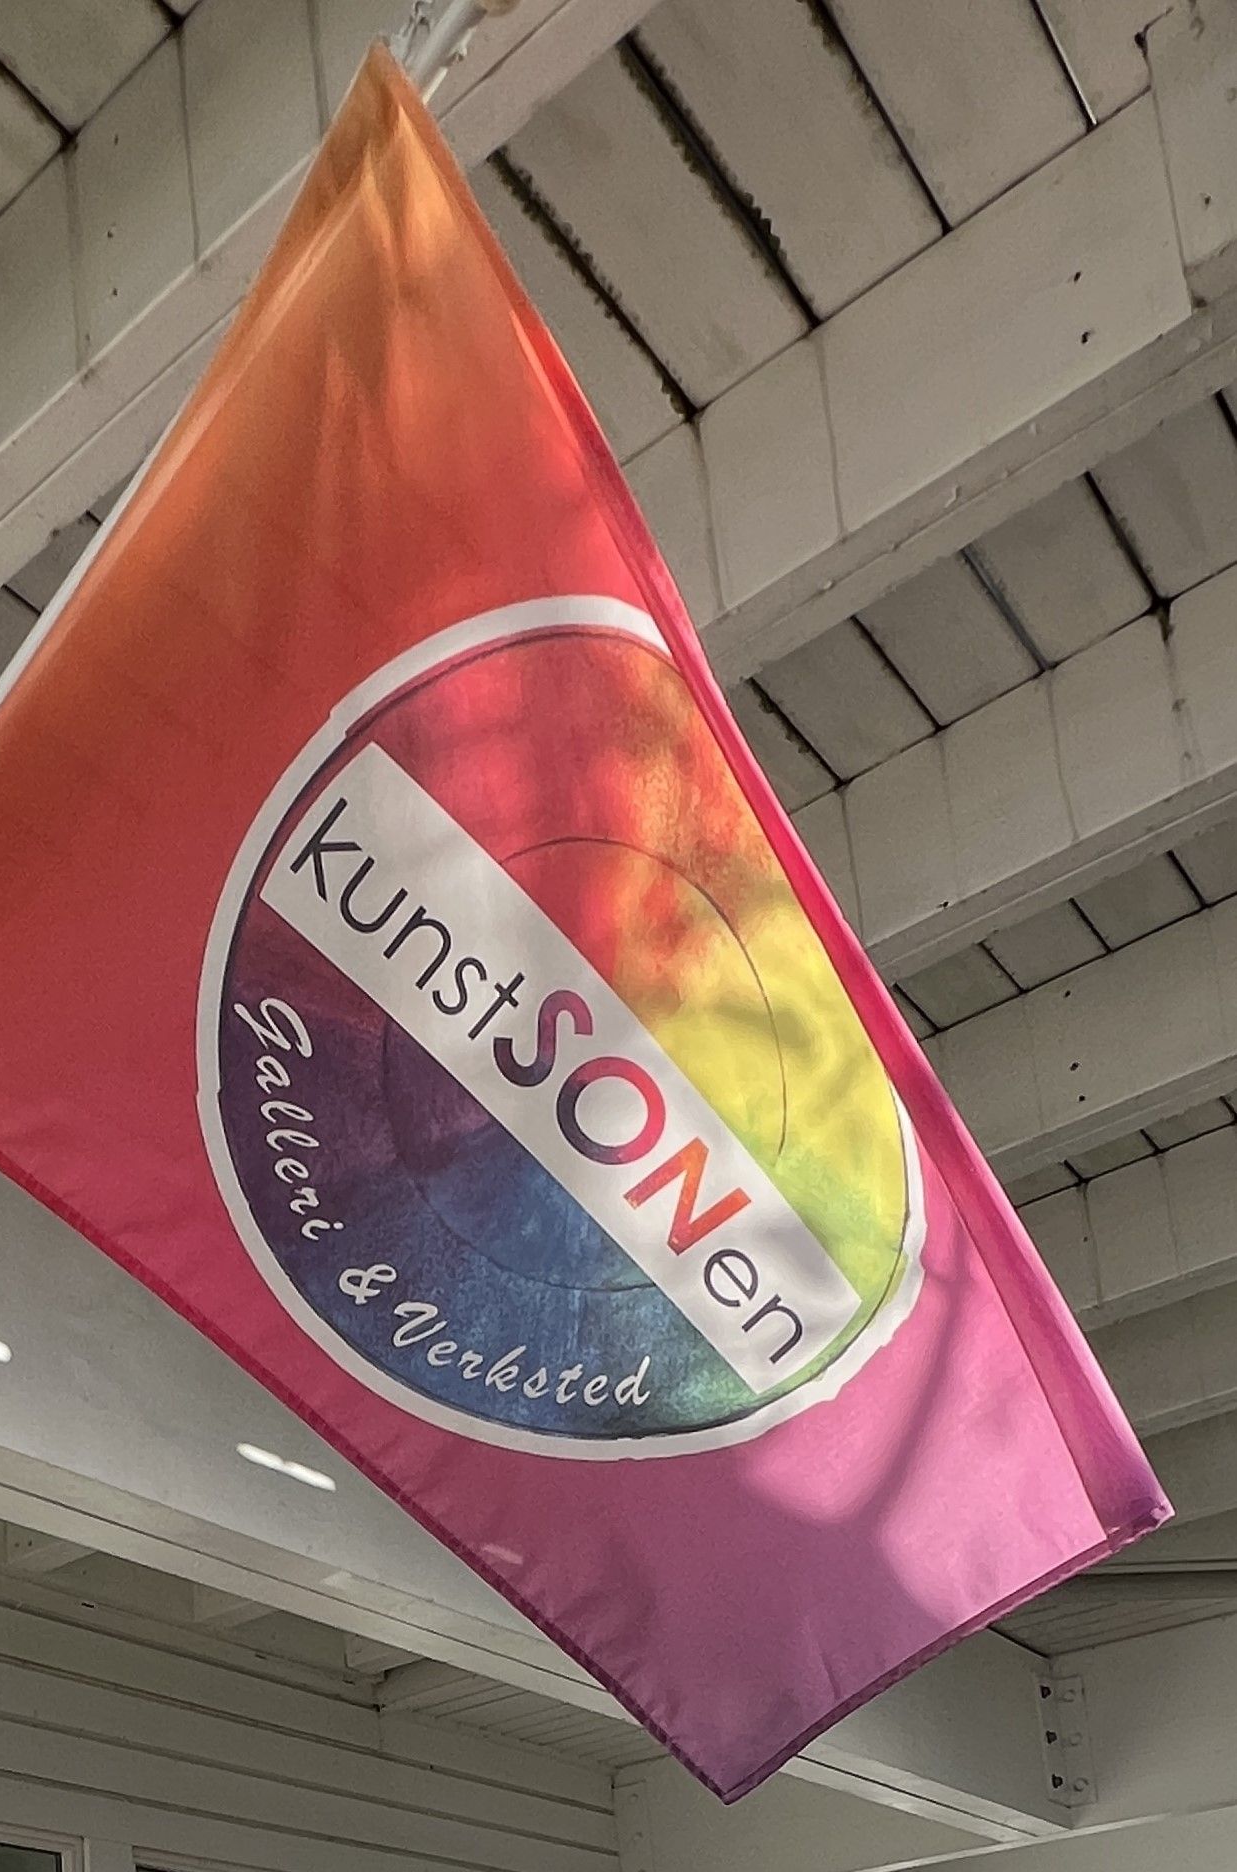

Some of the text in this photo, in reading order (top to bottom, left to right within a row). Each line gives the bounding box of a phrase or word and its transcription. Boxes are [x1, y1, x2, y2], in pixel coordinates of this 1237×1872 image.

[233, 996, 652, 1406] Galleri & Verksted
[289, 799, 804, 1364] kunstSONen
